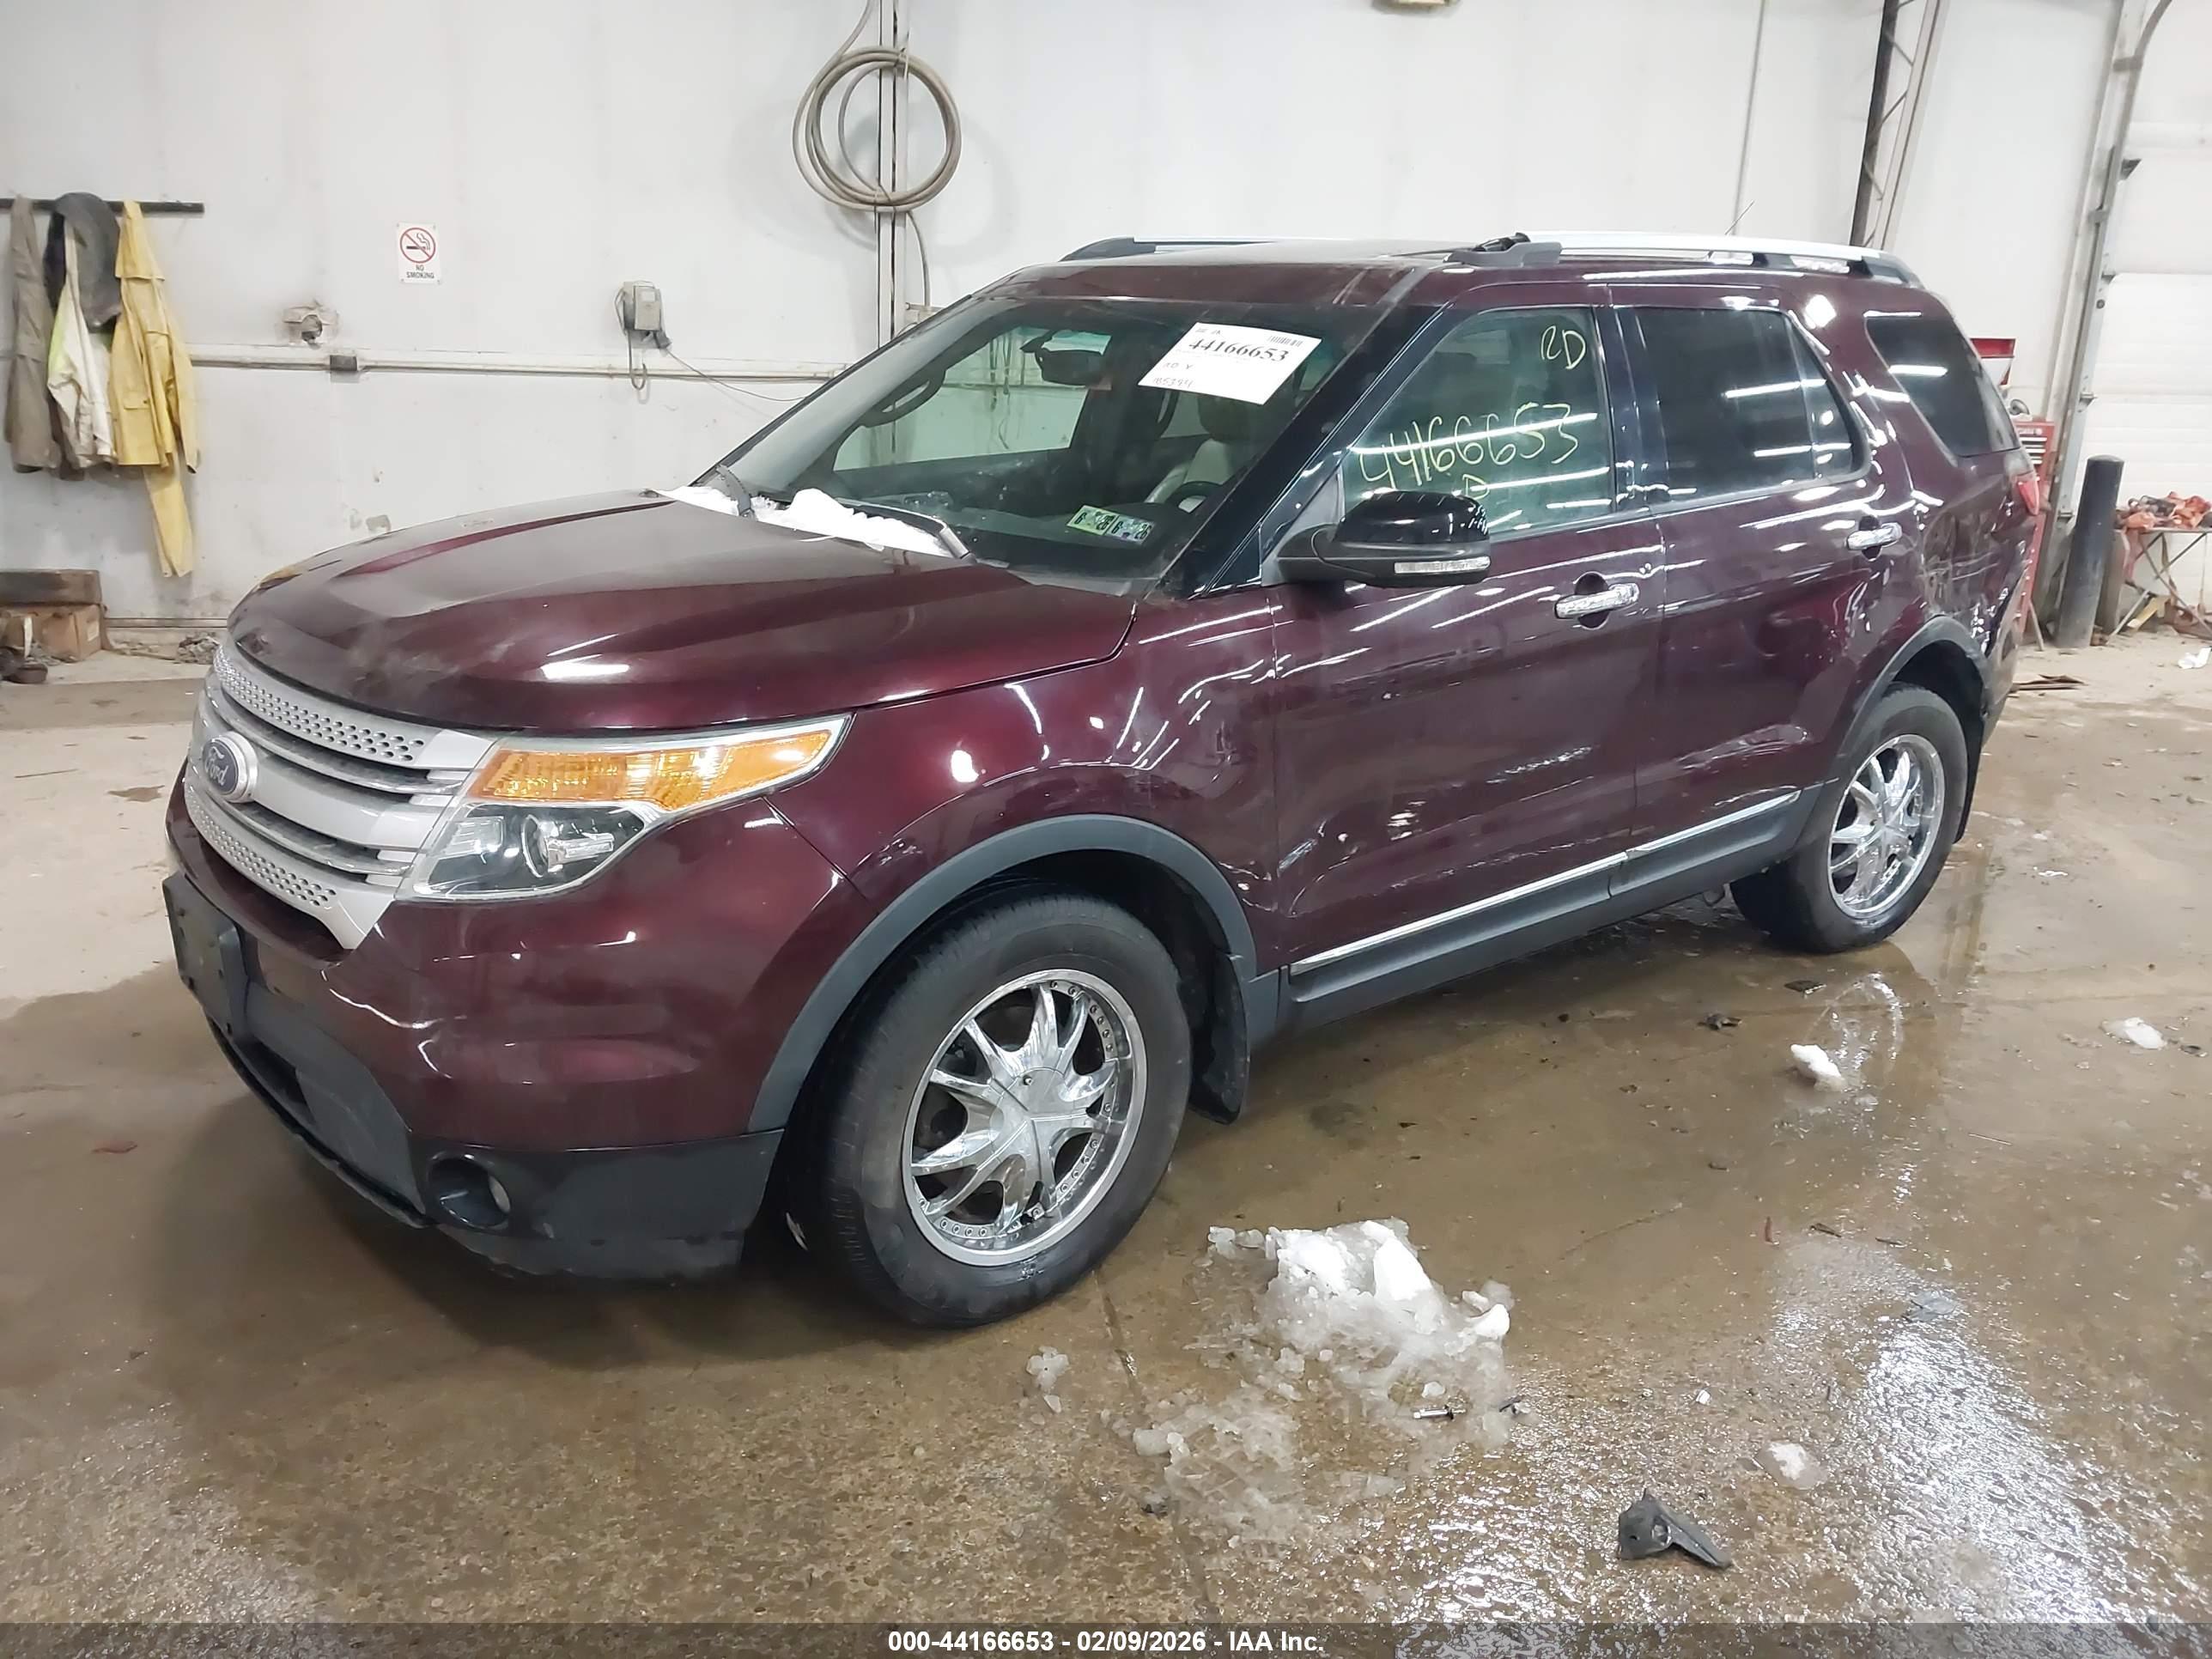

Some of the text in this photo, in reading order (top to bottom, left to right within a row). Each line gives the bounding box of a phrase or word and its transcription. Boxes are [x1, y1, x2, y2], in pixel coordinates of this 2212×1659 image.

[1188, 338, 1290, 362] 44166653
[1359, 402, 1578, 489] 44166653
[1074, 512, 1087, 525] 6
[1111, 520, 1124, 534] 6
[205, 745, 229, 786] Ford
